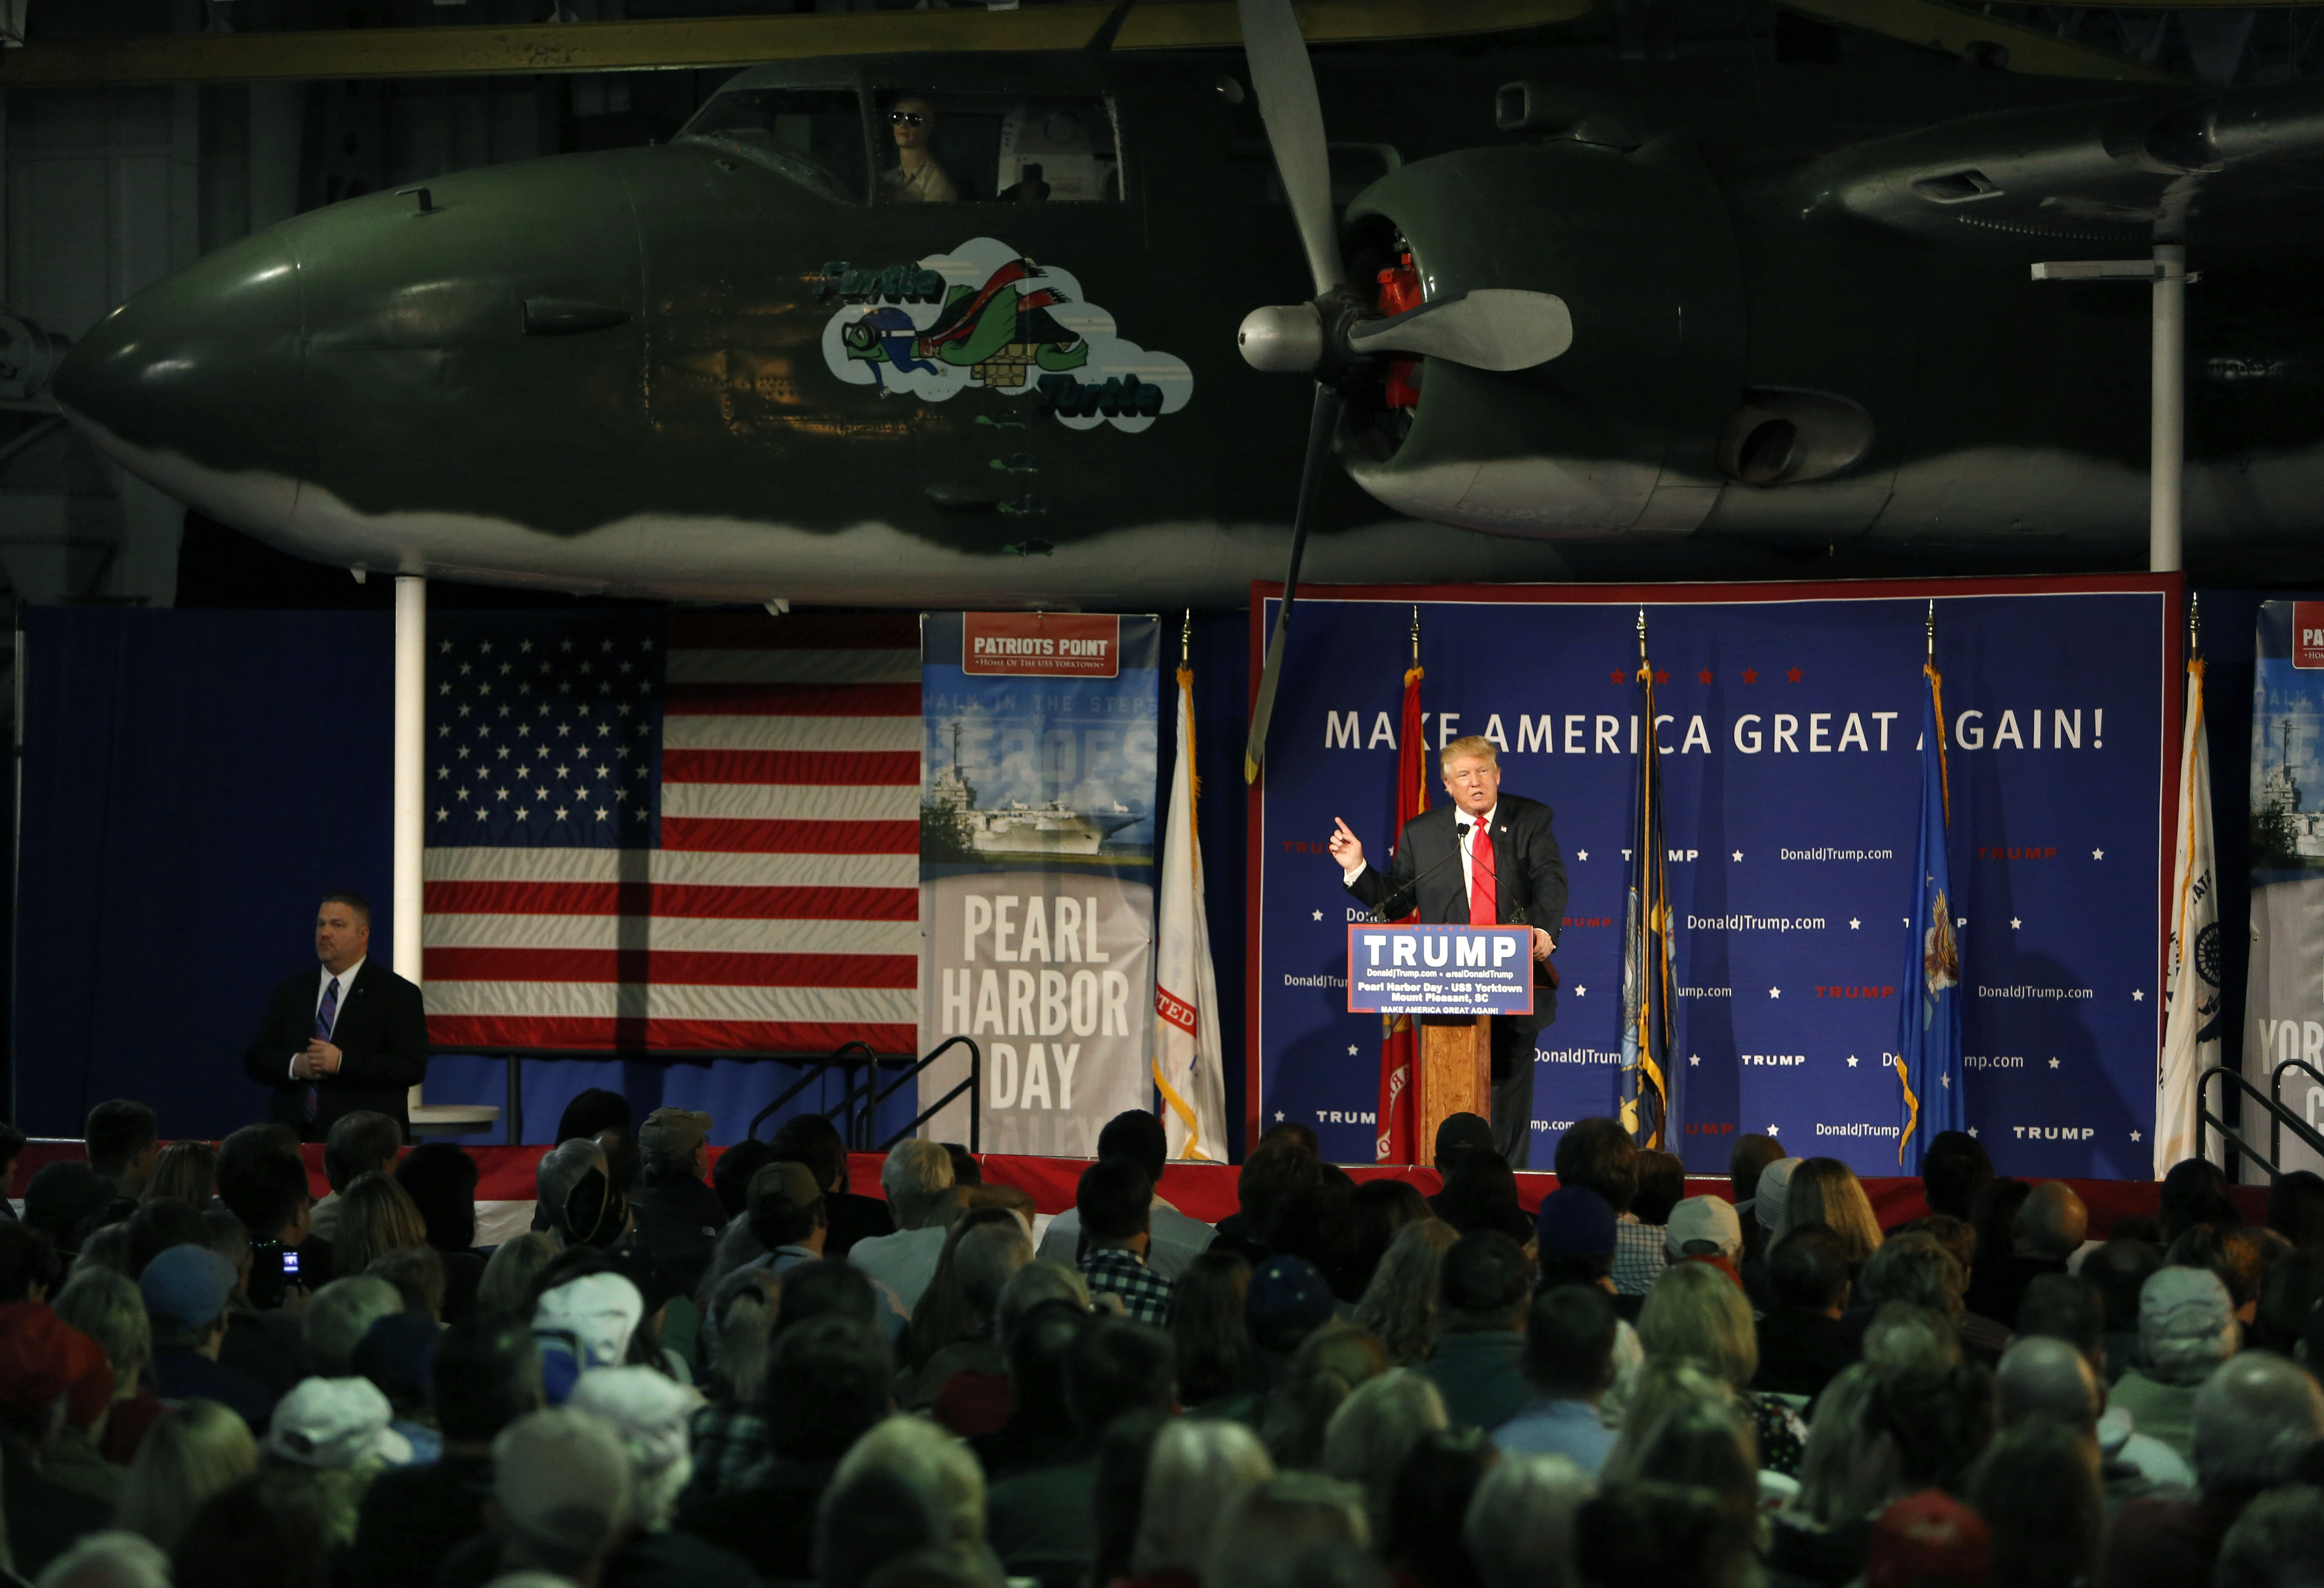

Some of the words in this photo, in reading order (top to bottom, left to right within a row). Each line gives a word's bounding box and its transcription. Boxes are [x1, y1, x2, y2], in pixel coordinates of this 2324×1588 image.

[974, 637, 1054, 655] PATRIOTS
[1059, 639, 1108, 656] POINT
[1484, 714, 1711, 754] AMERICA
[1734, 711, 1898, 753] GREAT
[1283, 841, 1332, 854] TRU
[1781, 847, 1892, 862] DonaldJTrump.com
[1977, 847, 2058, 859] TRUMP
[1621, 849, 1698, 862] TMP
[964, 894, 1109, 963] PEARL
[1563, 917, 1613, 927] RUMP
[1687, 914, 1825, 933] DonaldJTrump.com
[1364, 935, 1517, 967] TRUMP
[1367, 968, 1437, 979] DonaldJTrump.com
[1358, 982, 1384, 991] Pearl
[1386, 982, 1421, 992] Harbor
[1423, 983, 1443, 994] Day
[1451, 983, 1472, 992] USS
[1474, 983, 1522, 993] Yorktown
[1815, 986, 1894, 998] TRUMP
[1978, 985, 2093, 1000] DonaldJTrump.com
[942, 969, 1130, 1036] HARBOR
[1391, 992, 1423, 1002] Mount
[1425, 993, 1472, 1004] Pleasant,
[1474, 993, 1489, 1002] SC
[1158, 993, 1194, 1026] TED
[1742, 1055, 1805, 1066] TRUMP
[990, 1042, 1080, 1110] DAY
[1316, 1110, 1376, 1124] TRUM
[1686, 1123, 1733, 1135] UMP
[1816, 1123, 1900, 1139] DonaldJTrump
[2013, 1126, 2094, 1140] TRUMP
